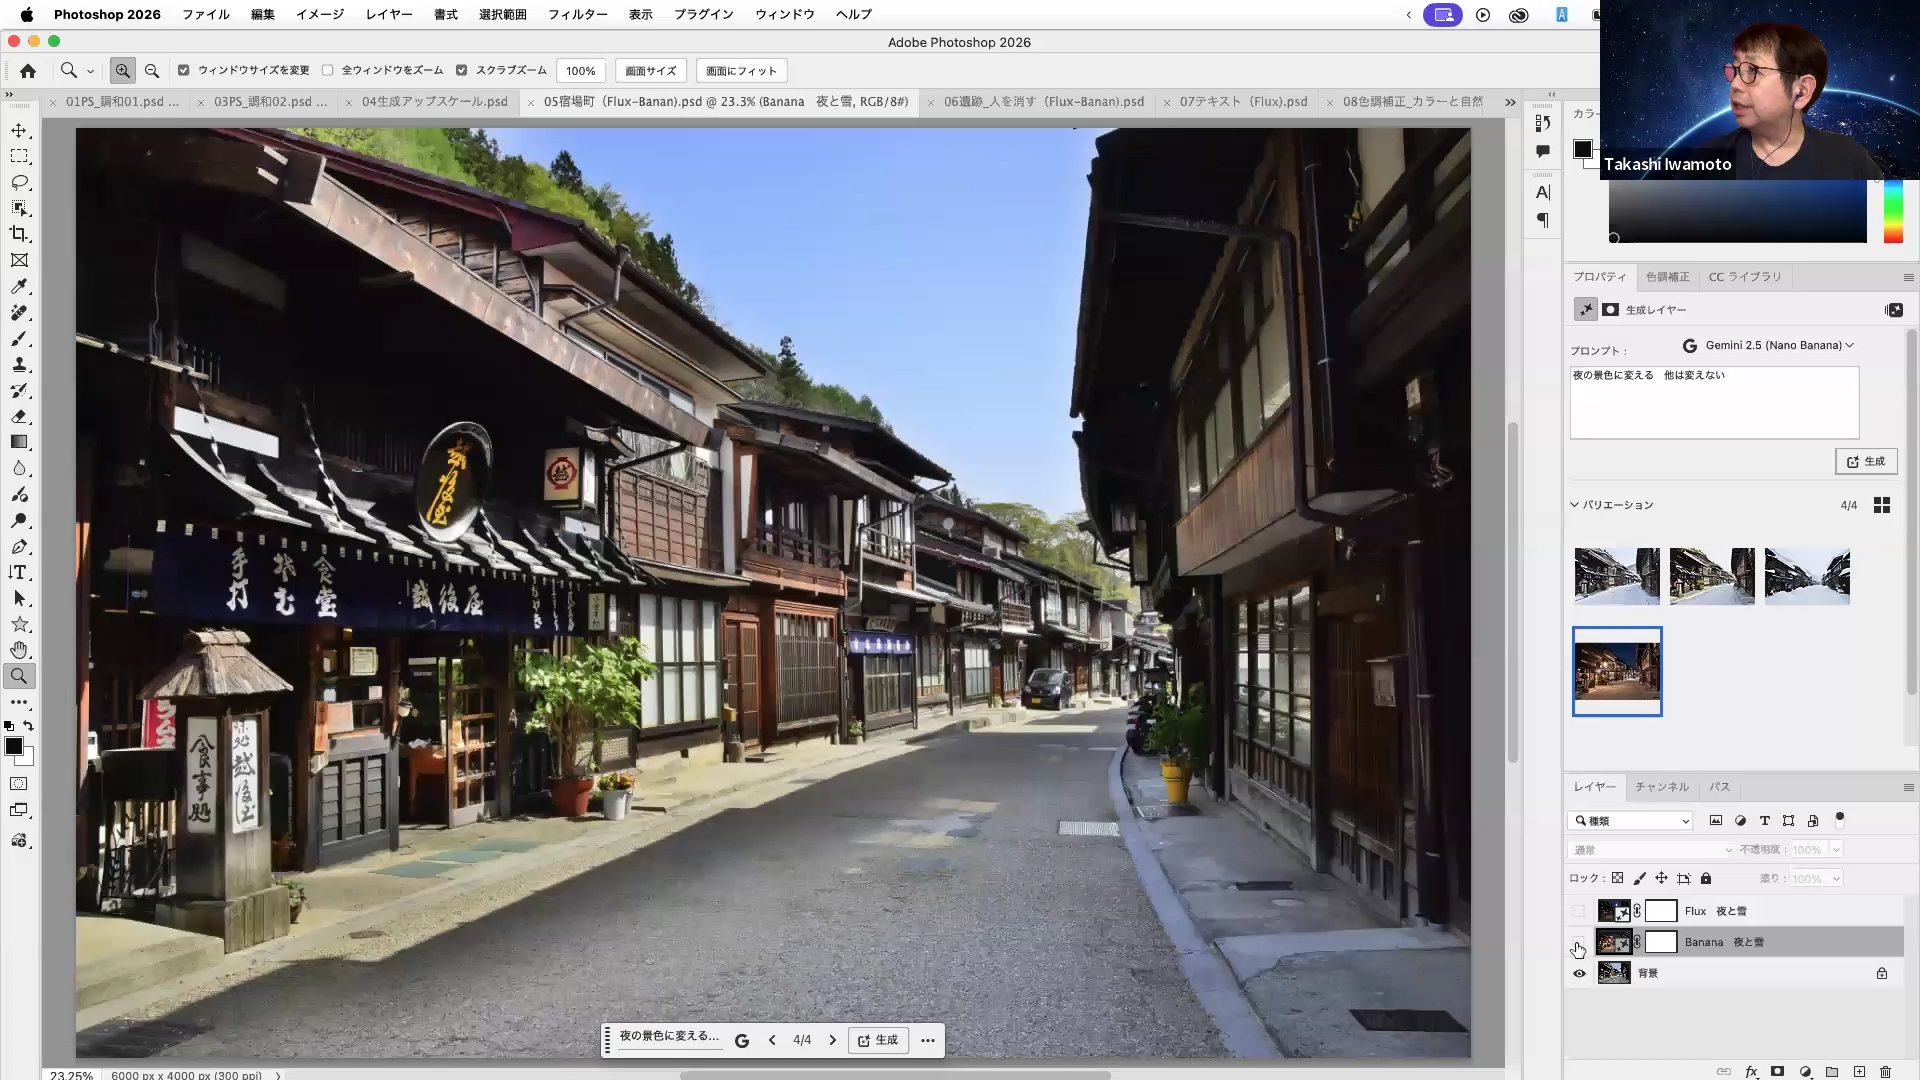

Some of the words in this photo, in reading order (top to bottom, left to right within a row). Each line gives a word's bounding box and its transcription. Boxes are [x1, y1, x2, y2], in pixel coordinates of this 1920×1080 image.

[54, 8, 124, 22] Photoshop
[127, 9, 162, 20] 2026
[183, 8, 231, 21] ファイル
[250, 7, 276, 21] 編集
[296, 7, 345, 21] イメージ
[366, 8, 413, 21] レイヤー
[434, 8, 459, 21] 書式
[479, 7, 527, 21] 選択範囲
[548, 8, 608, 21] フィルター
[628, 8, 654, 21] 表示
[674, 7, 734, 21] プラグイン
[756, 8, 815, 21] ウィンドウ
[835, 8, 873, 21] ヘルプ
[887, 36, 928, 48] Adobe
[930, 36, 997, 50] Photoshop
[999, 36, 1032, 48] 2026
[198, 64, 310, 76] ウィンドウサイズを変更
[341, 64, 444, 76] 全ウィンドウをズーム
[476, 64, 548, 76] スクラブズーム
[566, 66, 596, 76] 100%
[625, 65, 677, 77] 画面サイズ
[706, 65, 777, 77] 画面にフィット
[65, 95, 164, 110] 01PS_調和01.psd
[214, 95, 312, 109] 03PS_調和02.psd
[361, 95, 509, 110] 04生成アップスケール.psd
[706, 96, 718, 110] @
[720, 95, 756, 107] 23.3%
[759, 95, 805, 108] (Banana
[816, 94, 856, 109] 夜と雪,
[860, 95, 909, 109] RGB/8#)
[1573, 271, 1626, 283] プロパティ
[1645, 271, 1691, 283] 色調補正
[1708, 272, 1725, 282] CC
[1728, 271, 1781, 283] ライブラリ
[1625, 304, 1687, 316] 生成レイヤー
[1705, 339, 1743, 350] Gemini
[1745, 340, 1762, 351] 2.5
[1765, 339, 1797, 352] (Nano
[1800, 340, 1843, 352] Banana)
[1572, 369, 1654, 381] 夜の景色に変える
[1663, 369, 1726, 381] 他は変えない
[1864, 455, 1886, 467] 生成
[1582, 499, 1654, 511] バリエーション
[1840, 499, 1858, 512] 4/4
[226, 546, 249, 612] 手打
[313, 556, 337, 618] 食堂
[412, 578, 484, 616] 越後屋
[188, 734, 215, 823] 食事処
[1574, 781, 1617, 793] レイヤー
[1635, 781, 1690, 793] チャンネル
[1709, 781, 1731, 792] パス
[1588, 815, 1610, 827] 種類
[1574, 844, 1596, 856] 通常
[1792, 845, 1822, 856] 100%
[1792, 874, 1822, 885] 100%
[1685, 906, 1707, 916] Flux
[1715, 905, 1748, 917] 夜と雪
[1685, 937, 1724, 947] Banana
[1733, 936, 1765, 948] 夜と雪
[1637, 967, 1659, 979] 背景
[792, 1033, 812, 1047] 4/4
[875, 1033, 899, 1046] 生成
[49, 1071, 94, 1080] 23.25%
[110, 1070, 140, 1080] 6000
[157, 1072, 164, 1080] x
[166, 1071, 195, 1080] 4000
[214, 1070, 240, 1080] (300
